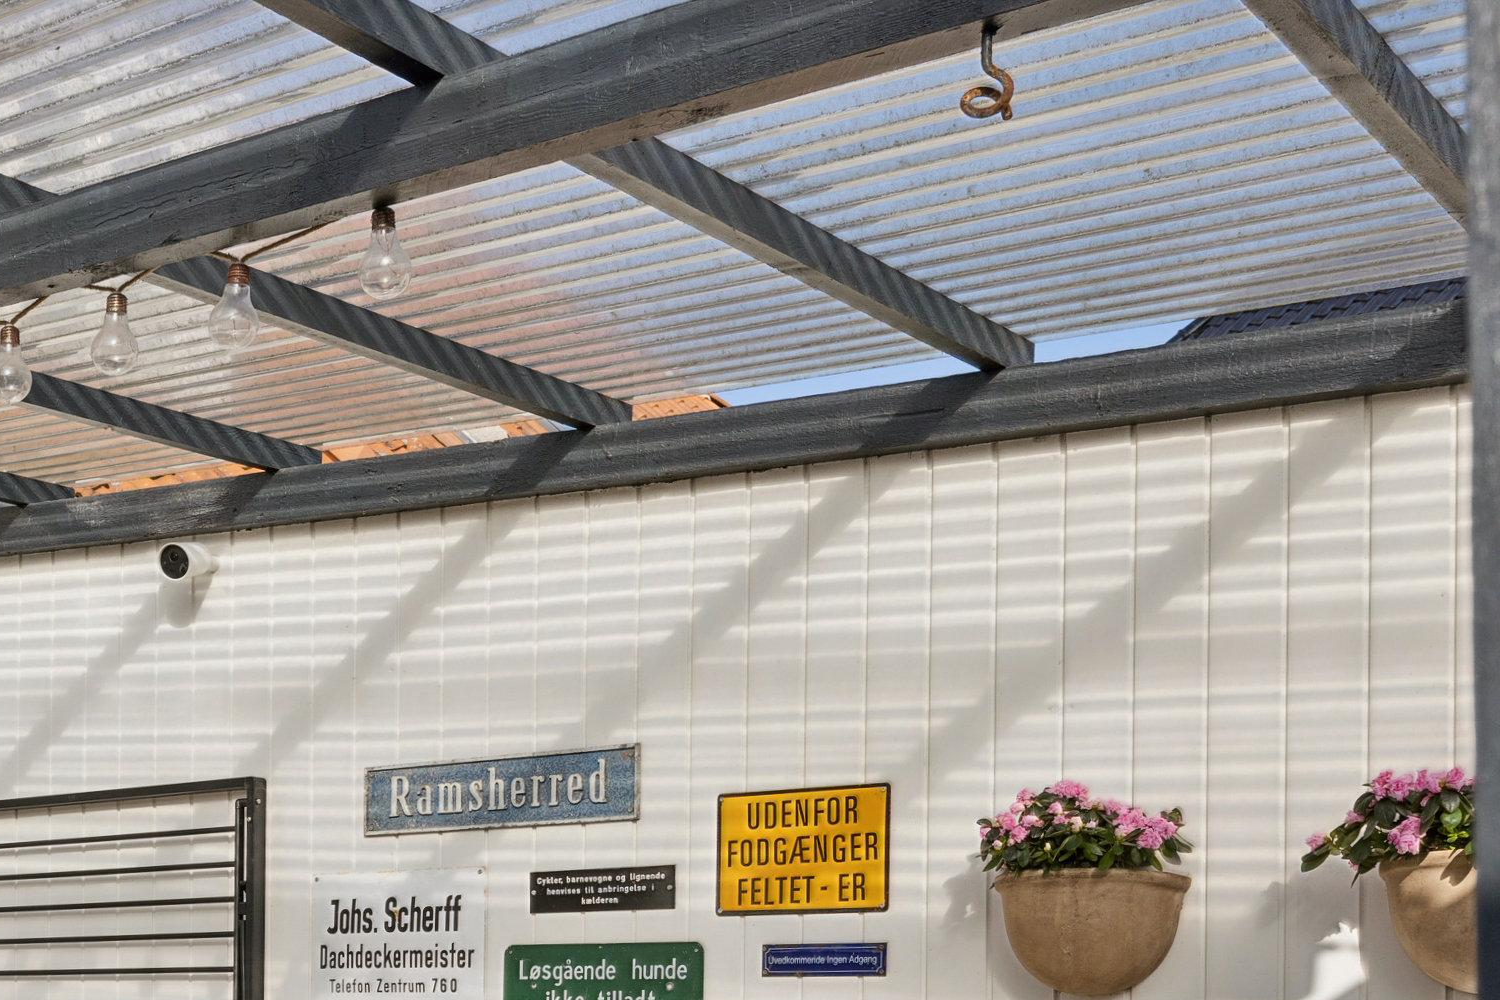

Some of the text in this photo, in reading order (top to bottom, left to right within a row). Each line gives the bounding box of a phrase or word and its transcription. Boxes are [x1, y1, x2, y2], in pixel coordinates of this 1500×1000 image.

[389, 758, 608, 818] Ramsherred
[747, 795, 858, 830] UDENFOR
[727, 832, 879, 868] FODGÆNGER
[536, 871, 666, 886] Cykler, barnevogne og lignende
[546, 887, 581, 896] henvises
[584, 886, 595, 894] til
[597, 884, 647, 894] anbringelse
[737, 875, 816, 906] FELTET
[838, 873, 866, 902] ER
[327, 894, 462, 935] Johs. Scherff
[581, 897, 619, 905] kælderen
[320, 943, 475, 970] Dachdeckermeister
[767, 954, 878, 966] Uvedkommende Ingen Adgang
[329, 978, 458, 993] Telefon Zentrum 760
[518, 957, 688, 986] Løsgående hunde
